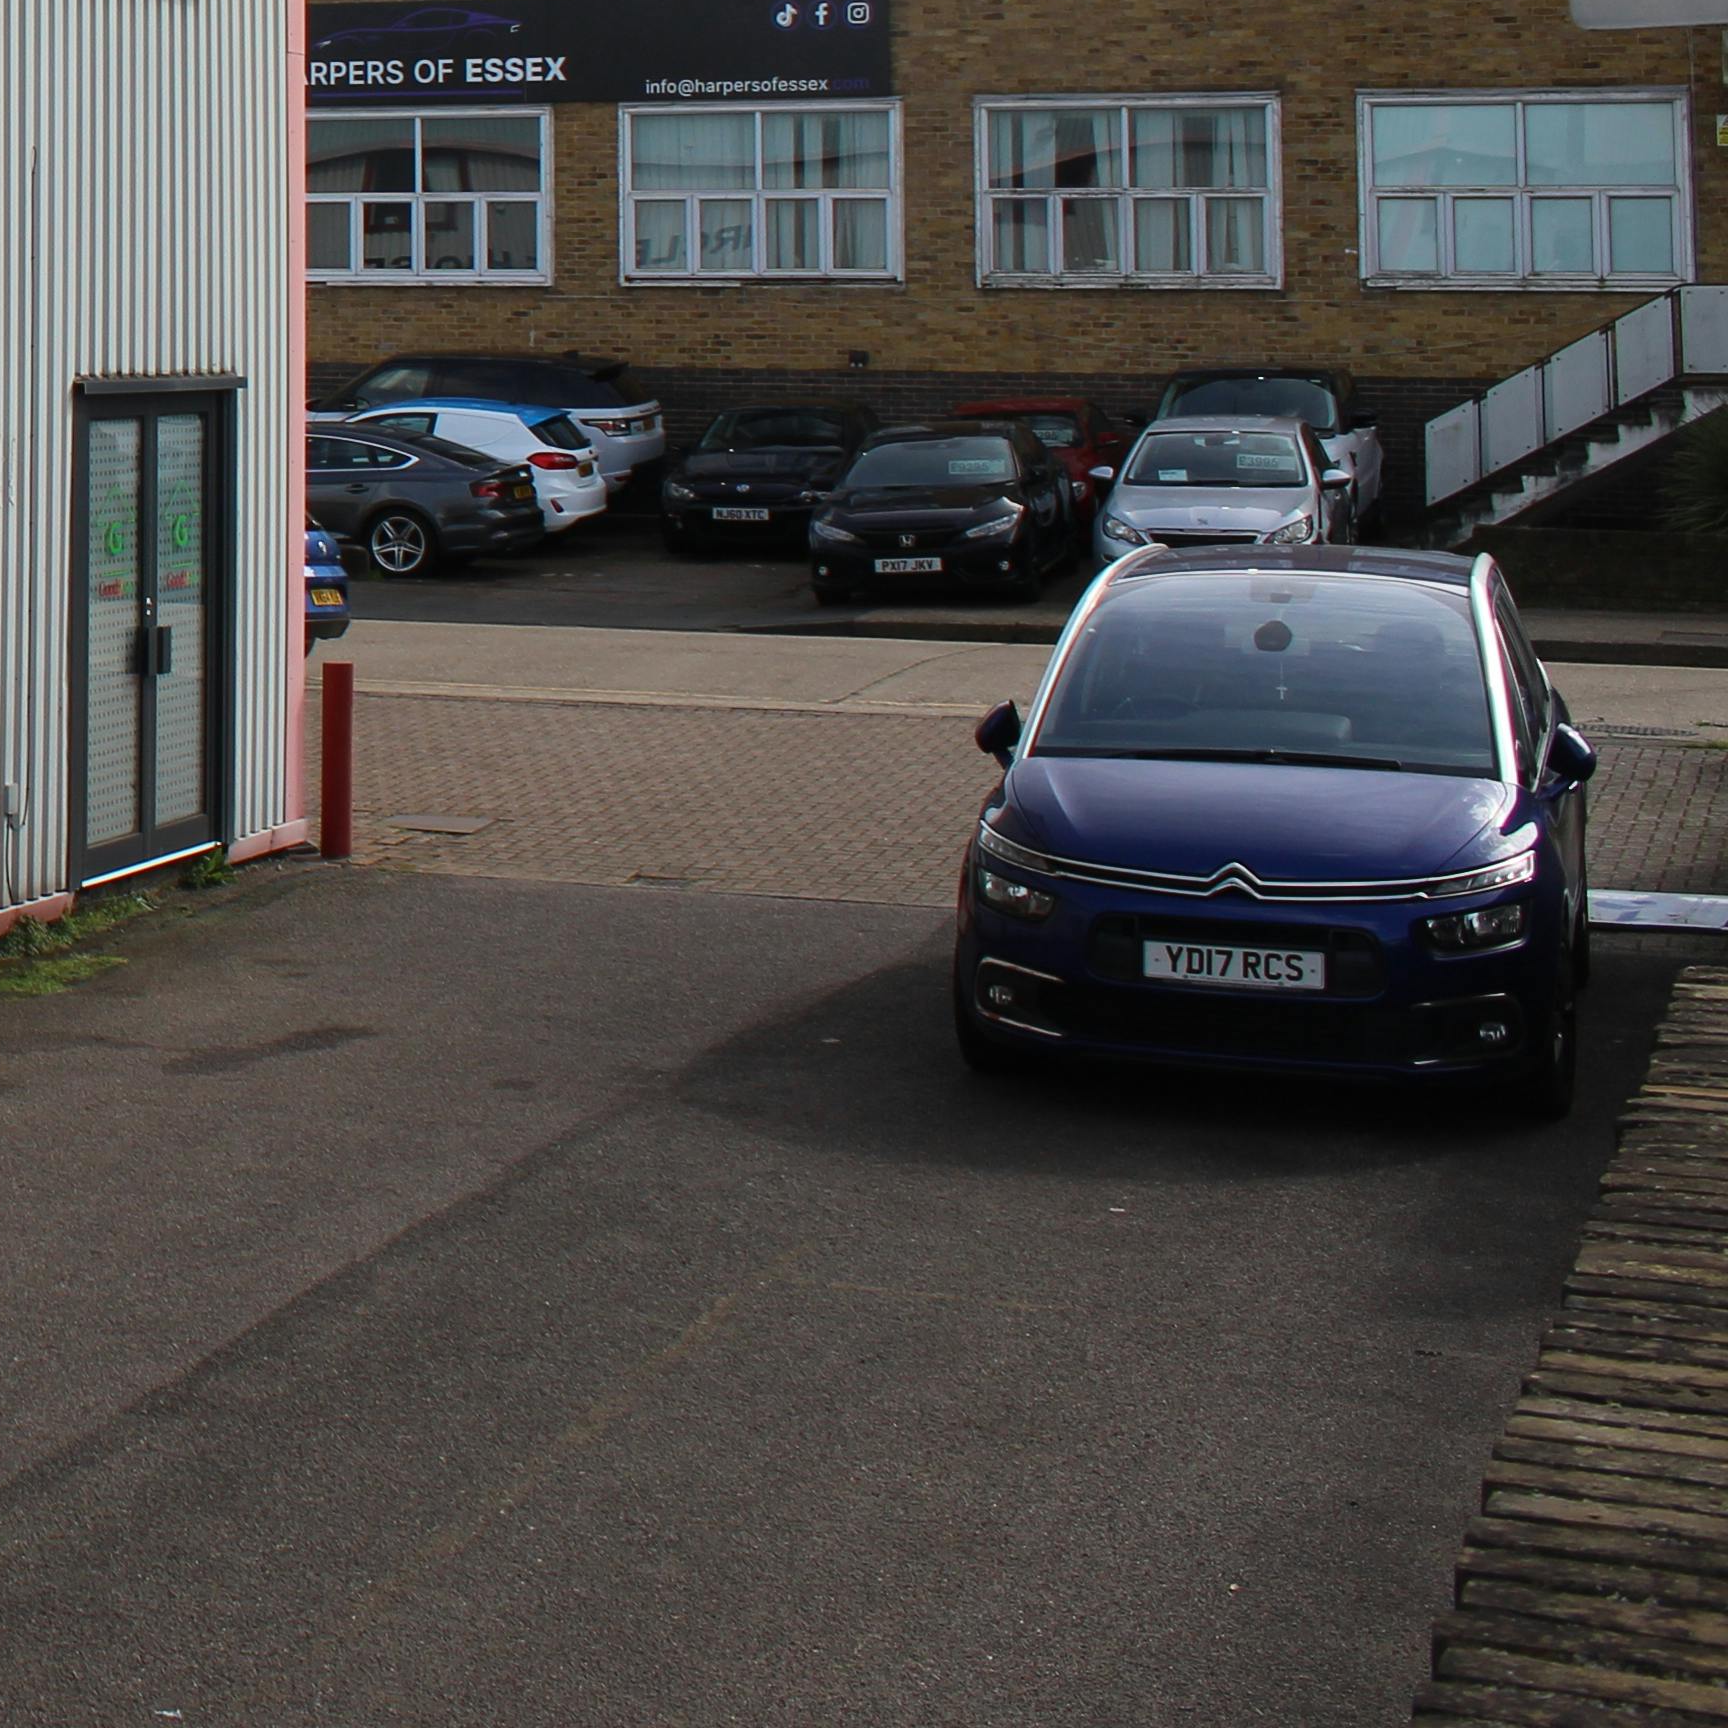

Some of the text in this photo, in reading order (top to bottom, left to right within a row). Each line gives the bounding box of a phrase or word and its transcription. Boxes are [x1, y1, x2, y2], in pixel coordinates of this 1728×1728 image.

[305, 56, 567, 85] RPERS OF ESSEX
[645, 76, 869, 97] info@harpersofessexcom
[881, 559, 933, 571] PX17 JKV
[1165, 945, 1304, 982] YD17 RCS
